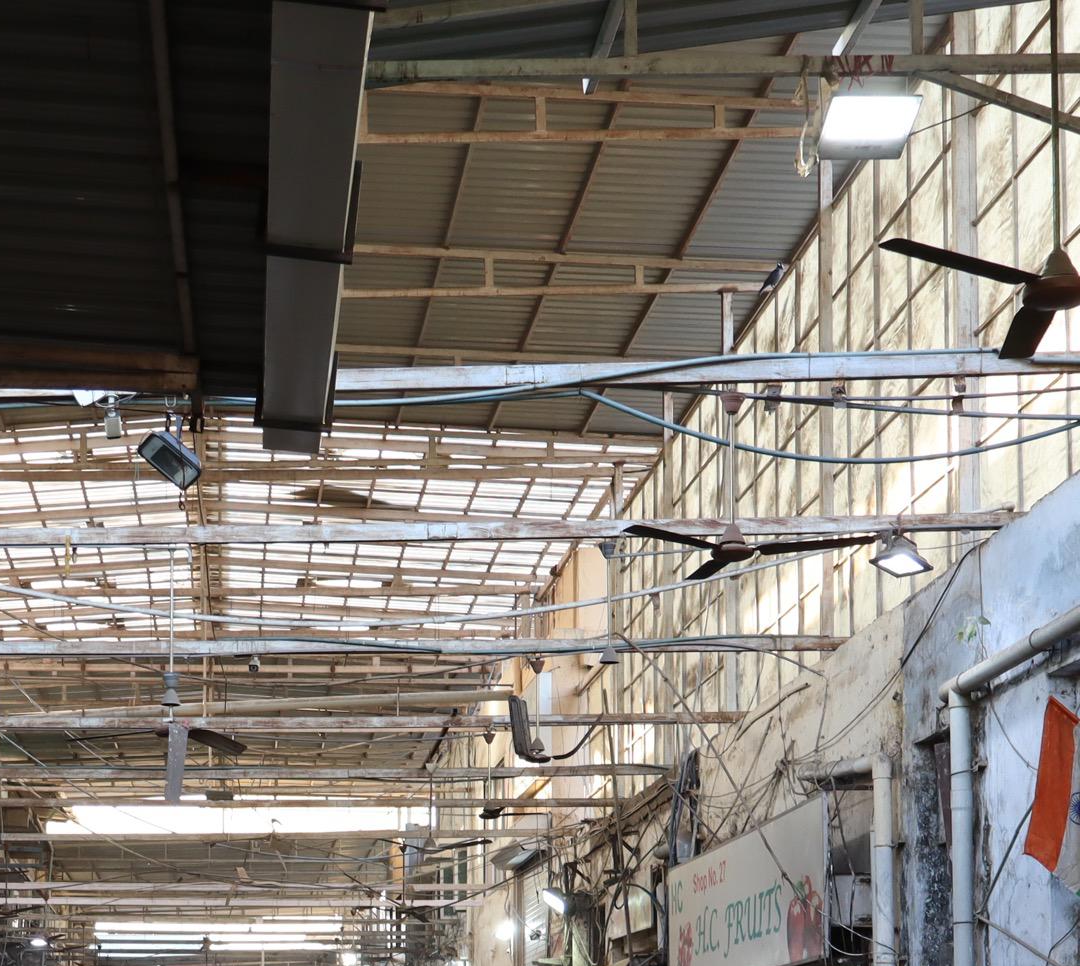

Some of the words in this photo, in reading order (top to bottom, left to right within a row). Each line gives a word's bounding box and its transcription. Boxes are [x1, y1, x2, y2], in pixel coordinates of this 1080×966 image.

[693, 873, 707, 897] Shop
[708, 866, 719, 887] No.
[719, 860, 727, 883] 27
[671, 880, 683, 916] HC
[695, 905, 720, 957] H.C.
[724, 880, 783, 959] FRUITS
